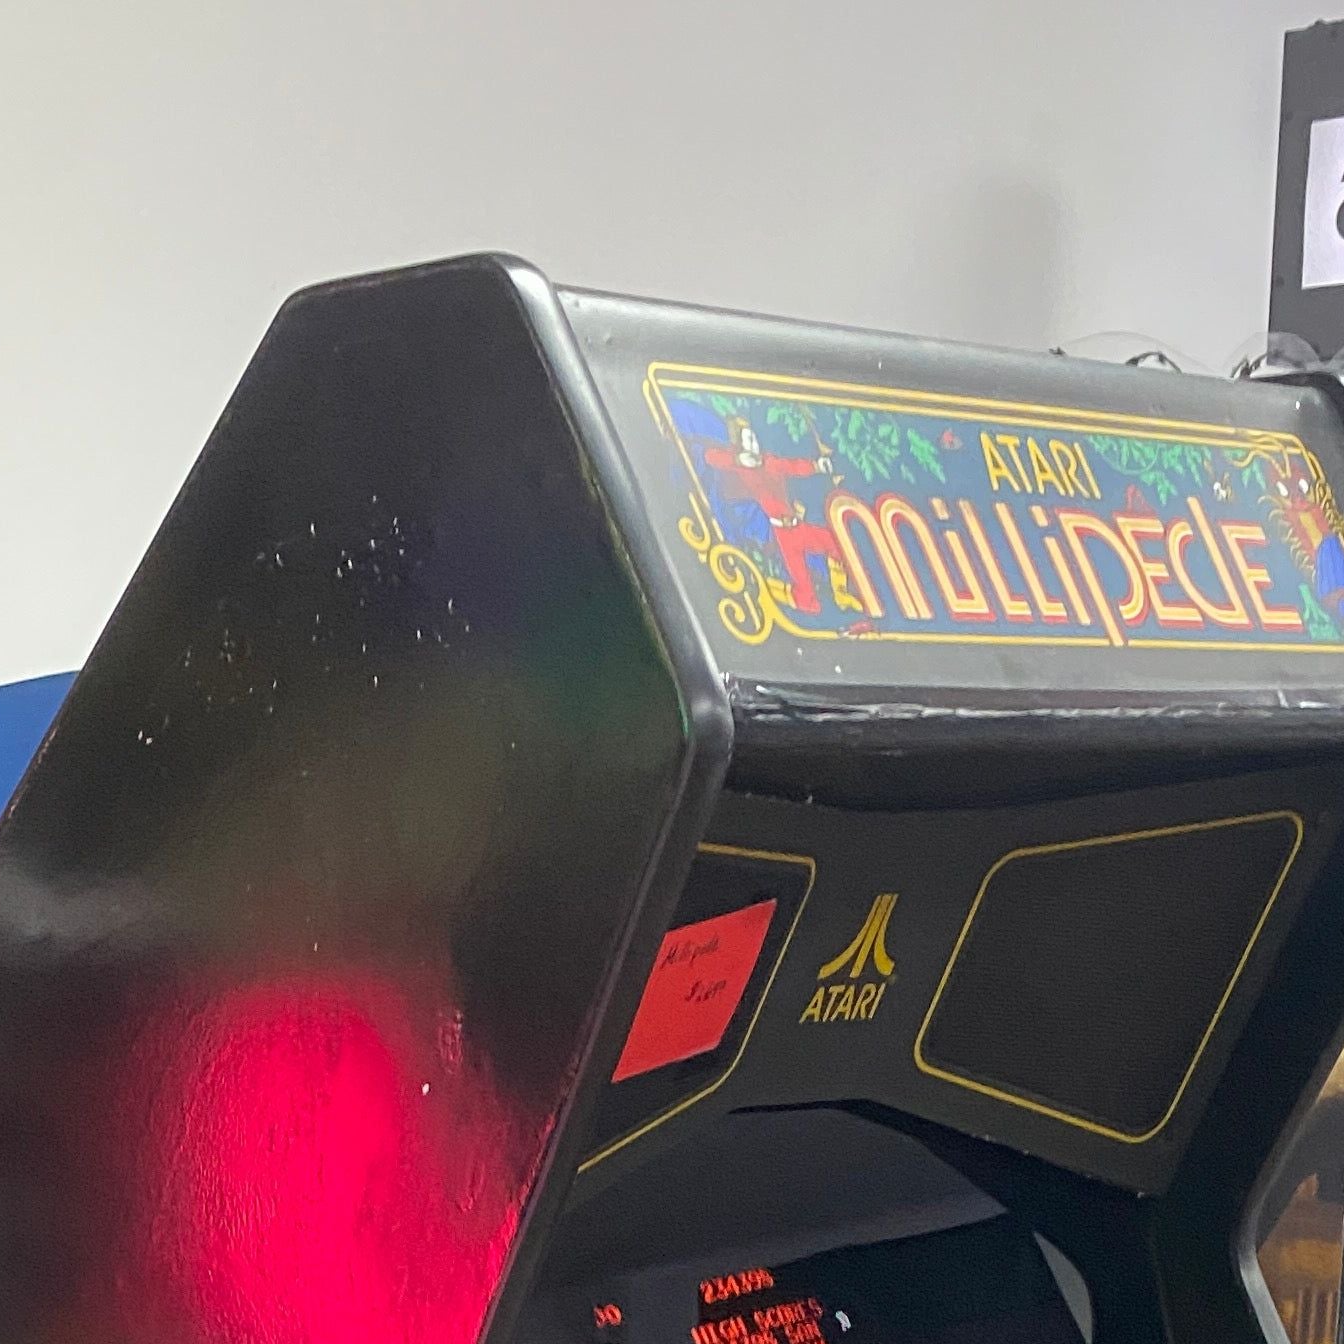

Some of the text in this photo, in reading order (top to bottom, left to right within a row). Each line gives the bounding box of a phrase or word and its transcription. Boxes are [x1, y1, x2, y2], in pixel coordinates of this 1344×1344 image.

[980, 432, 1101, 499] ATARI
[798, 982, 887, 1024] ATARI
[754, 1297, 825, 1331] SCORES
